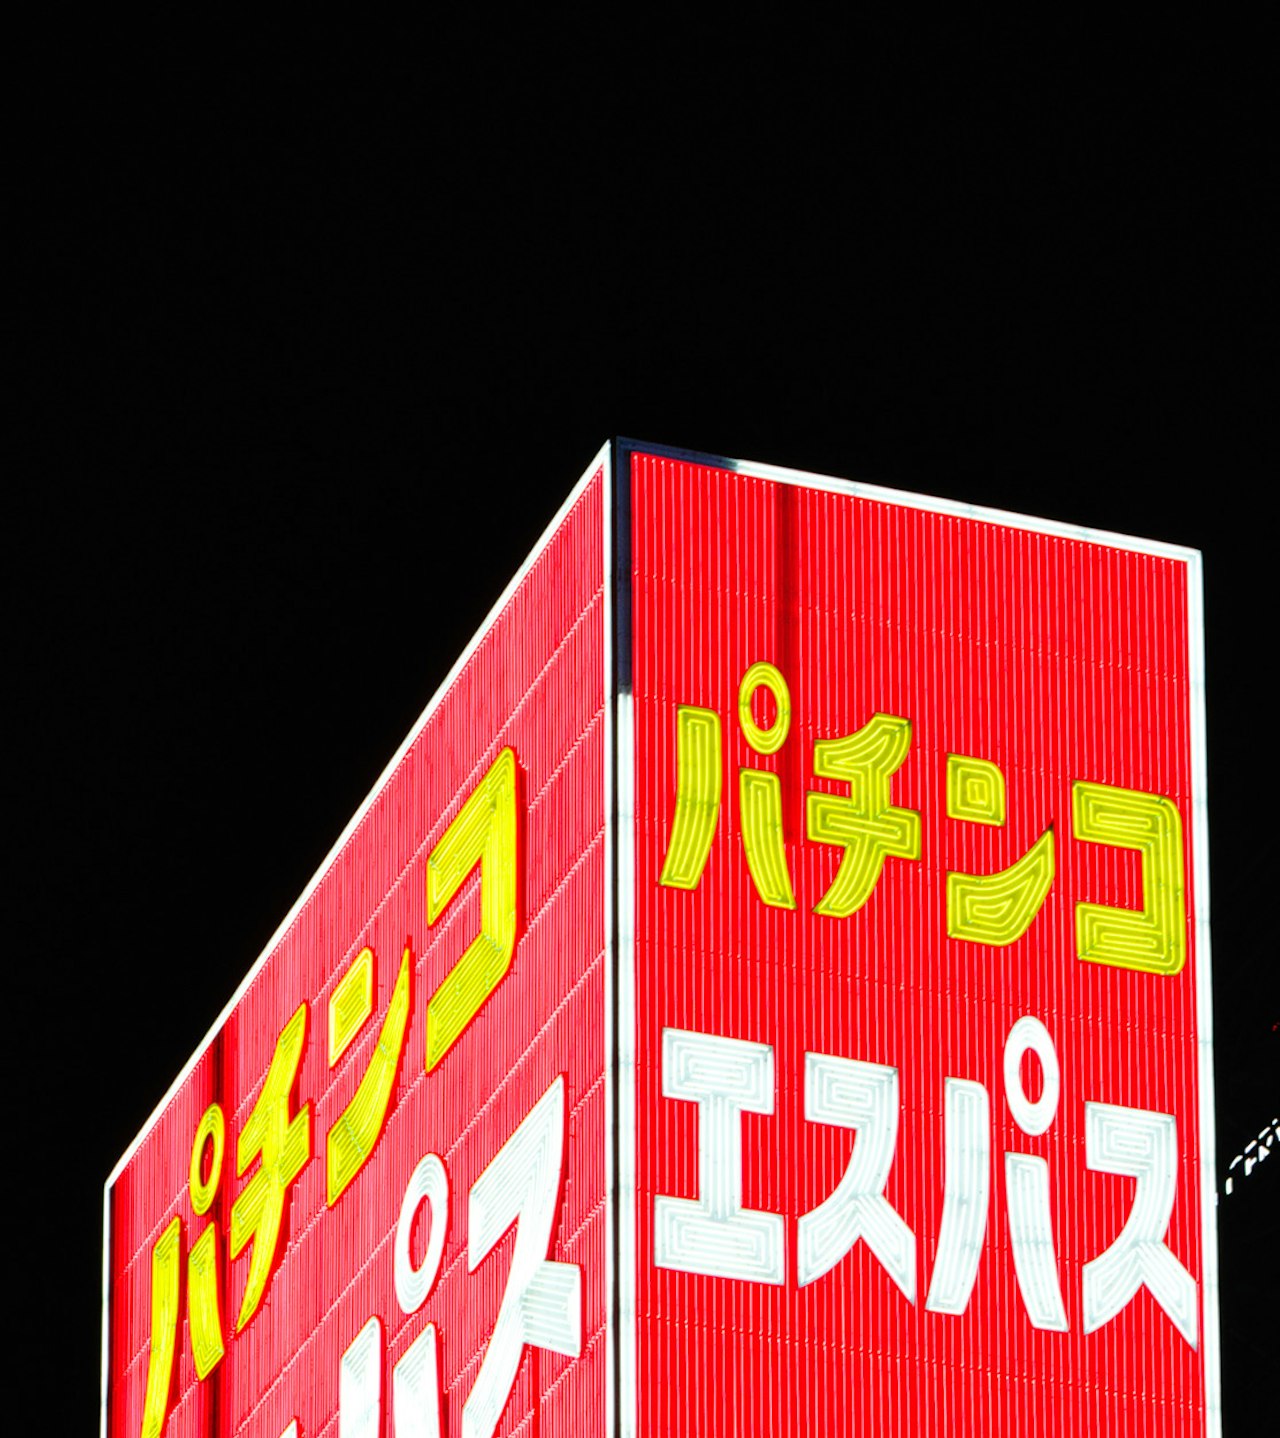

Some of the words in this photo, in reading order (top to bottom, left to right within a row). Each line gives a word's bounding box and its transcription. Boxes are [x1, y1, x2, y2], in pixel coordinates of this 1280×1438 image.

[660, 661, 1185, 977] パチンコ
[652, 1015, 1198, 1350] エスパス
